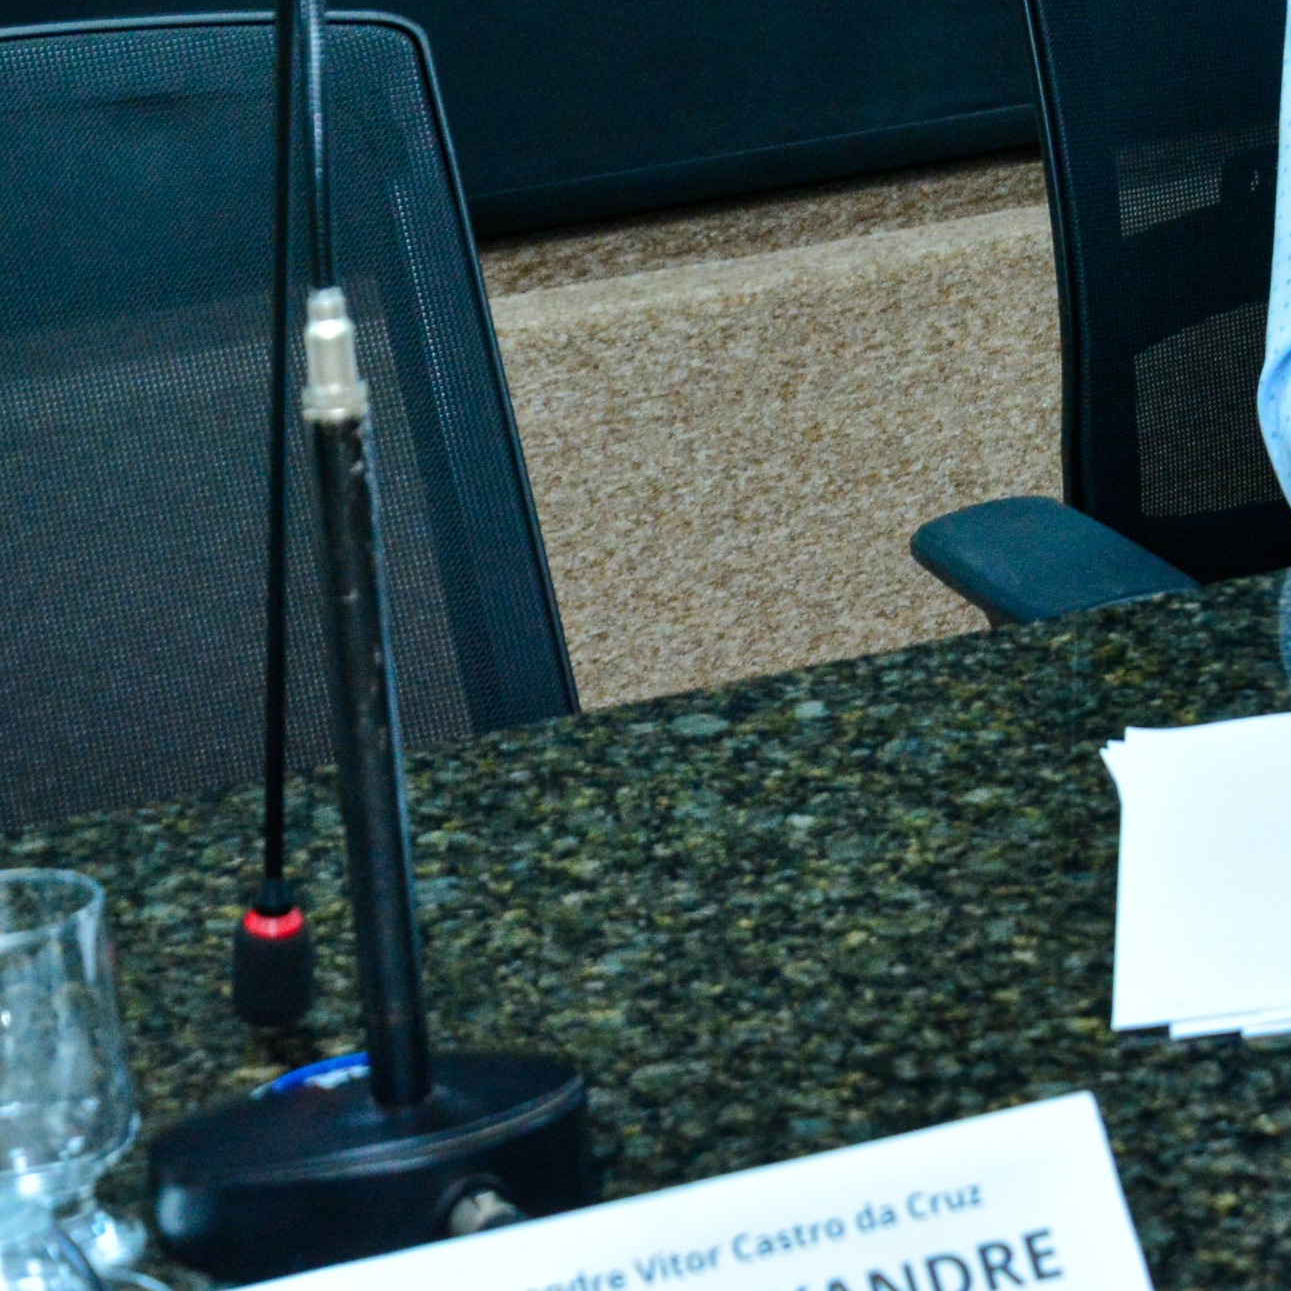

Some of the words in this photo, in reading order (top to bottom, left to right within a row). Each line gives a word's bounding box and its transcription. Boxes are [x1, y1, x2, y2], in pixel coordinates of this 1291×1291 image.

[525, 1270, 626, 1291] ndre
[632, 1244, 720, 1285] Vitor
[731, 1218, 846, 1261] Castro
[855, 1202, 898, 1232] da
[905, 1184, 983, 1220] Cruz
